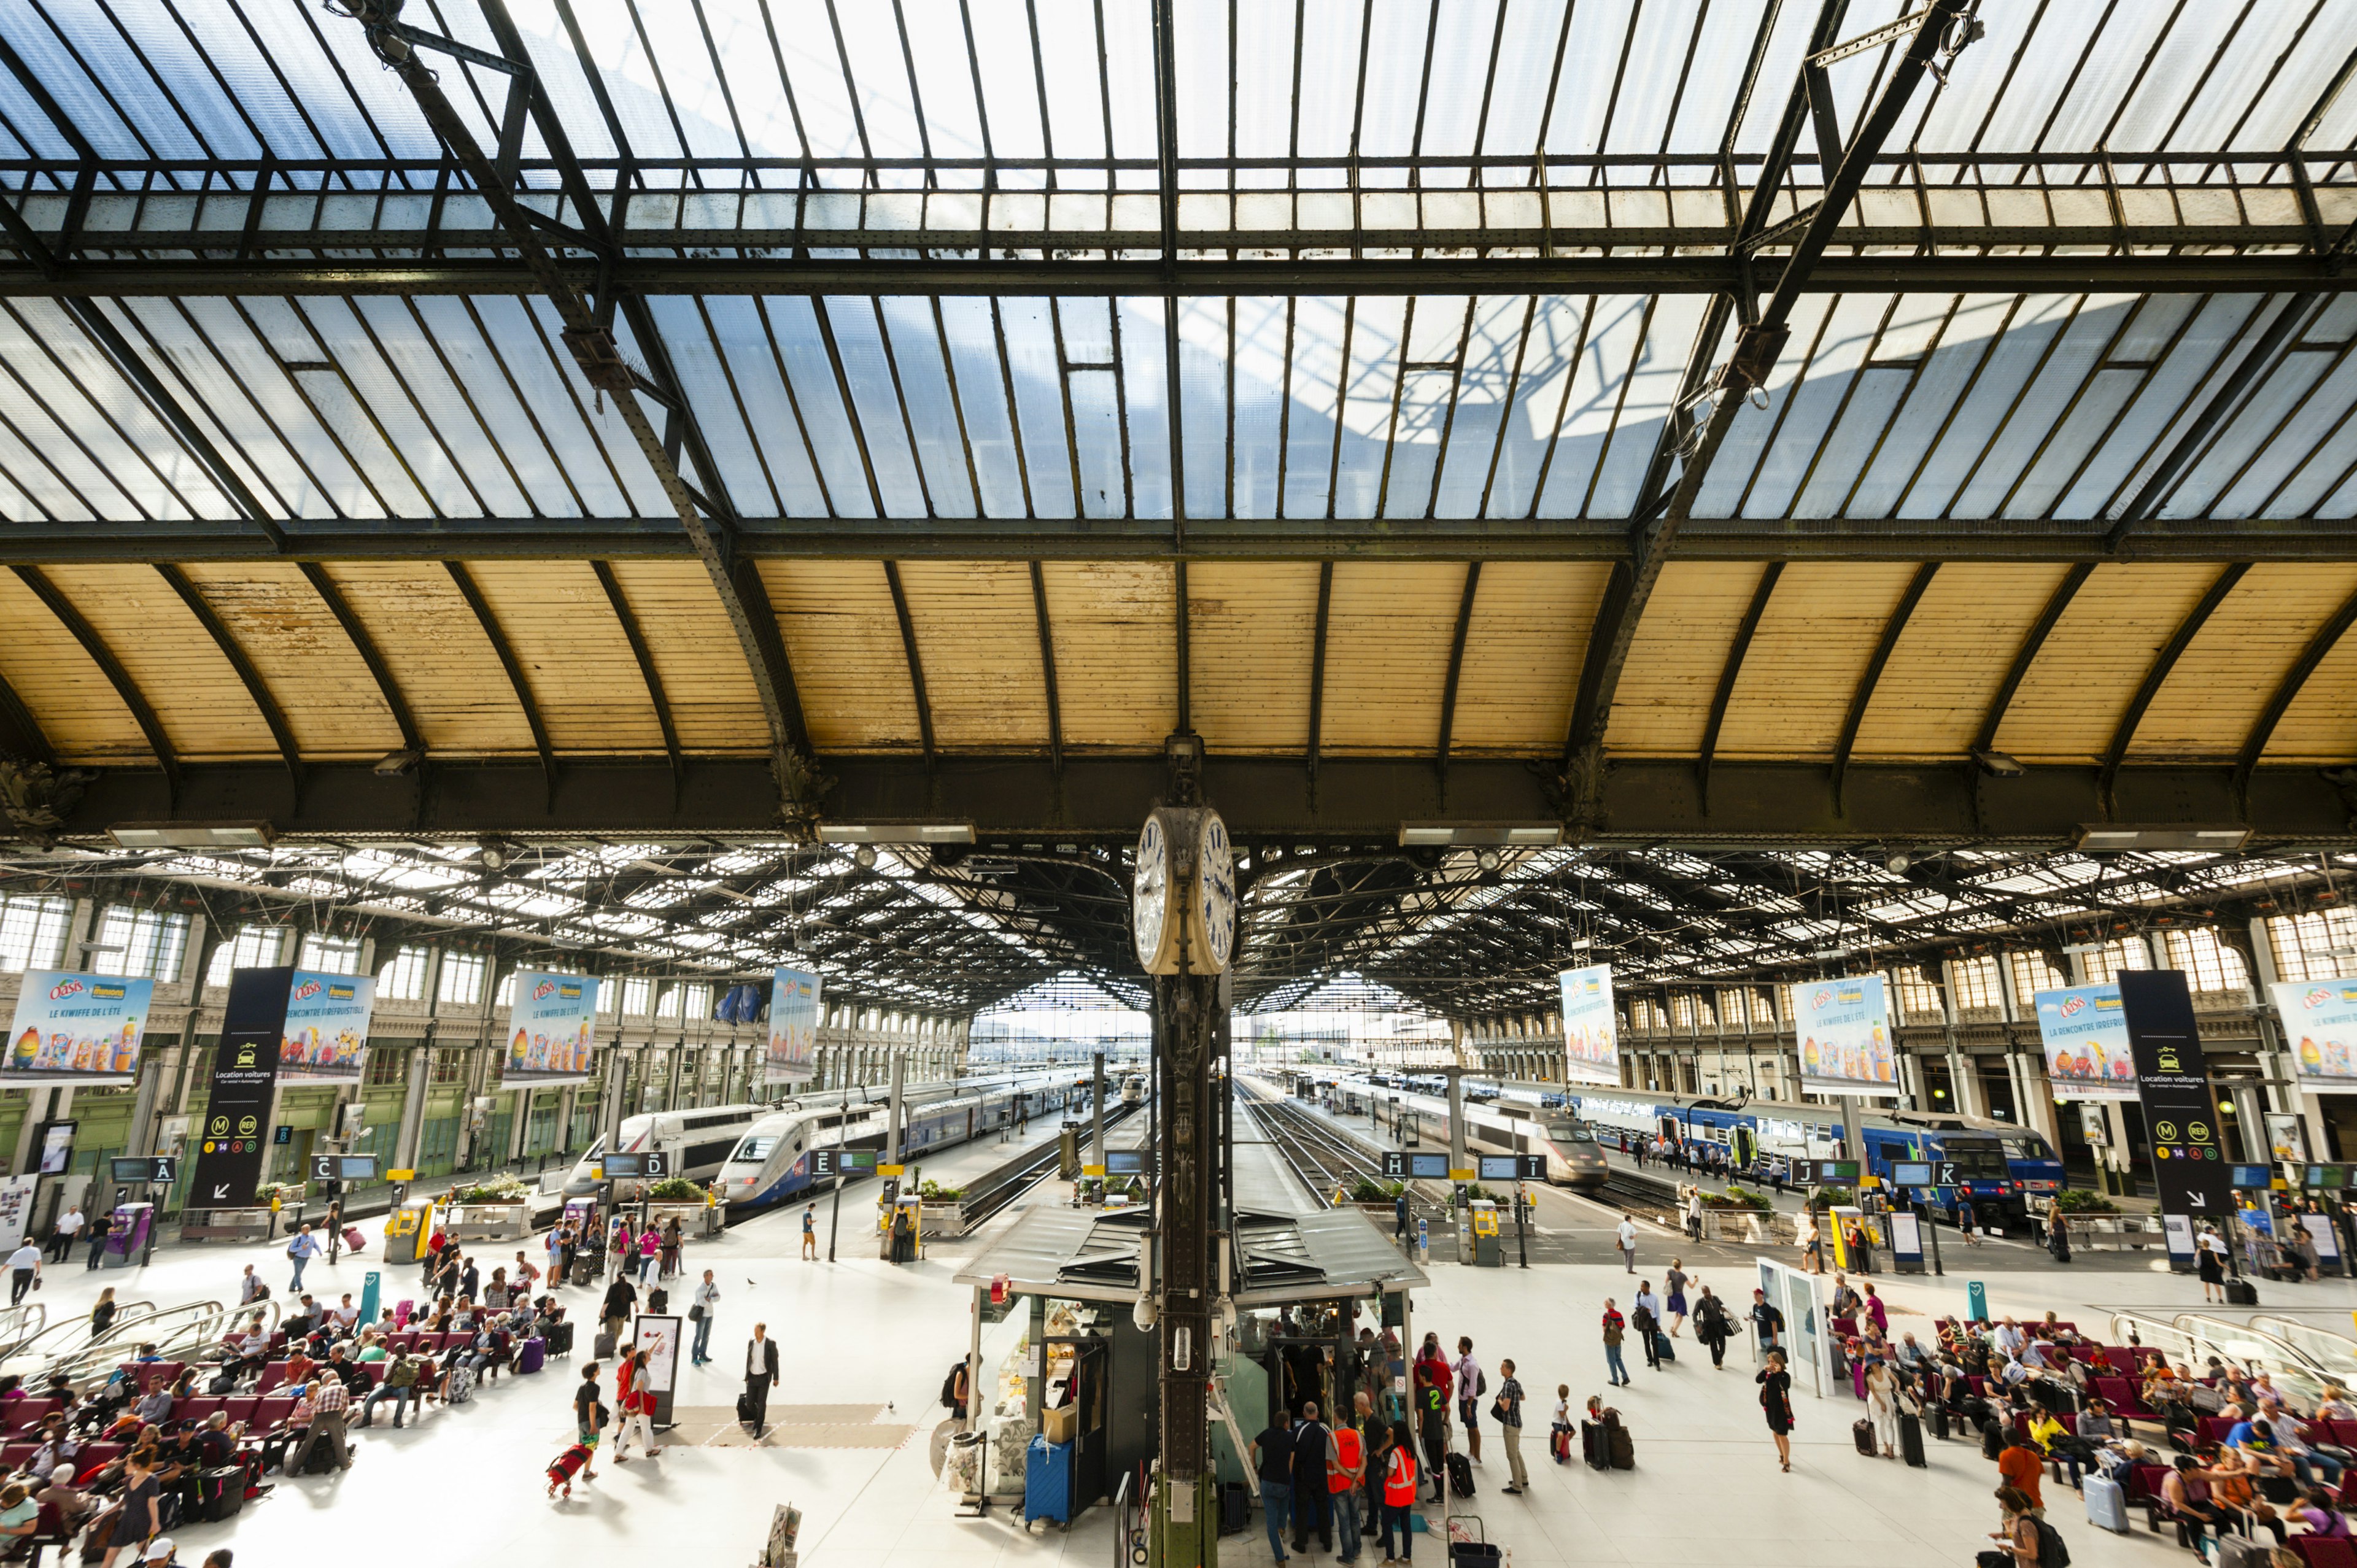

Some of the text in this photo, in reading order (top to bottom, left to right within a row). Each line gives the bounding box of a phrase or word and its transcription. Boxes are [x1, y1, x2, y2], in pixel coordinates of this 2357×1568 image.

[50, 979, 83, 1001] Oasis
[295, 981, 321, 1001] Oasis
[533, 980, 555, 1001] Oasis
[1812, 989, 1832, 1010] Oasis
[49, 1010, 58, 1018] LE
[60, 1008, 90, 1018] KIWIFFE
[91, 1008, 101, 1016] DE
[560, 1008, 566, 1016] DE
[2061, 996, 2086, 1018] Oasis
[1844, 1014, 1850, 1023] DE
[2059, 1023, 2094, 1035] RENCONTRE
[215, 1120, 225, 1131] M
[2160, 1125, 2207, 1136] M RER
[280, 1131, 287, 1141] B
[157, 1165, 169, 1178] A
[318, 1162, 330, 1176] C
[648, 1159, 660, 1173] D
[818, 1157, 828, 1172] E
[1389, 1159, 1401, 1173] H
[1800, 1167, 1810, 1181] J
[1941, 1168, 1954, 1183] K
[1430, 1389, 1441, 1410] 2
